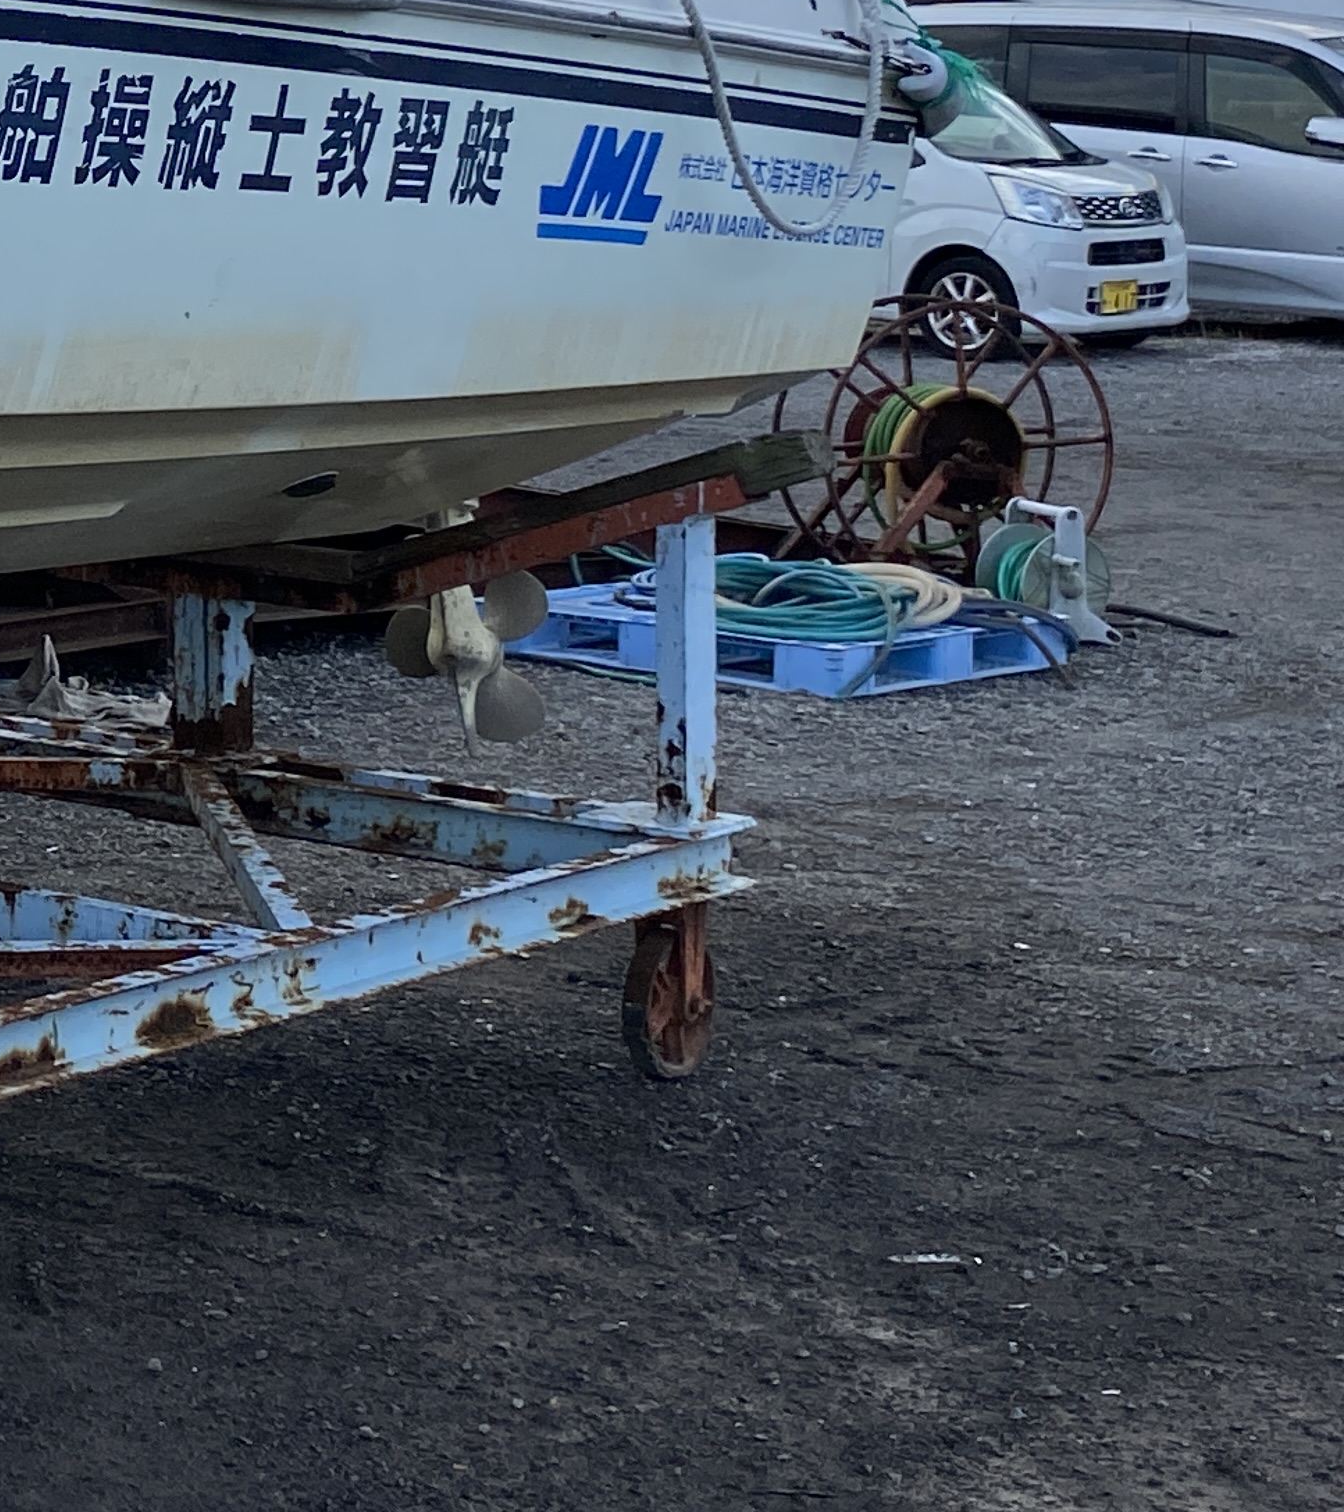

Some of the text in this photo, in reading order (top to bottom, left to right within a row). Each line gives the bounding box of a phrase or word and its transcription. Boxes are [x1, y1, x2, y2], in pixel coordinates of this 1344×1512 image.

[539, 124, 664, 223] JML
[664, 209, 715, 235] JAPAN
[717, 212, 771, 240] MARINE
[833, 224, 885, 249] CENTER
